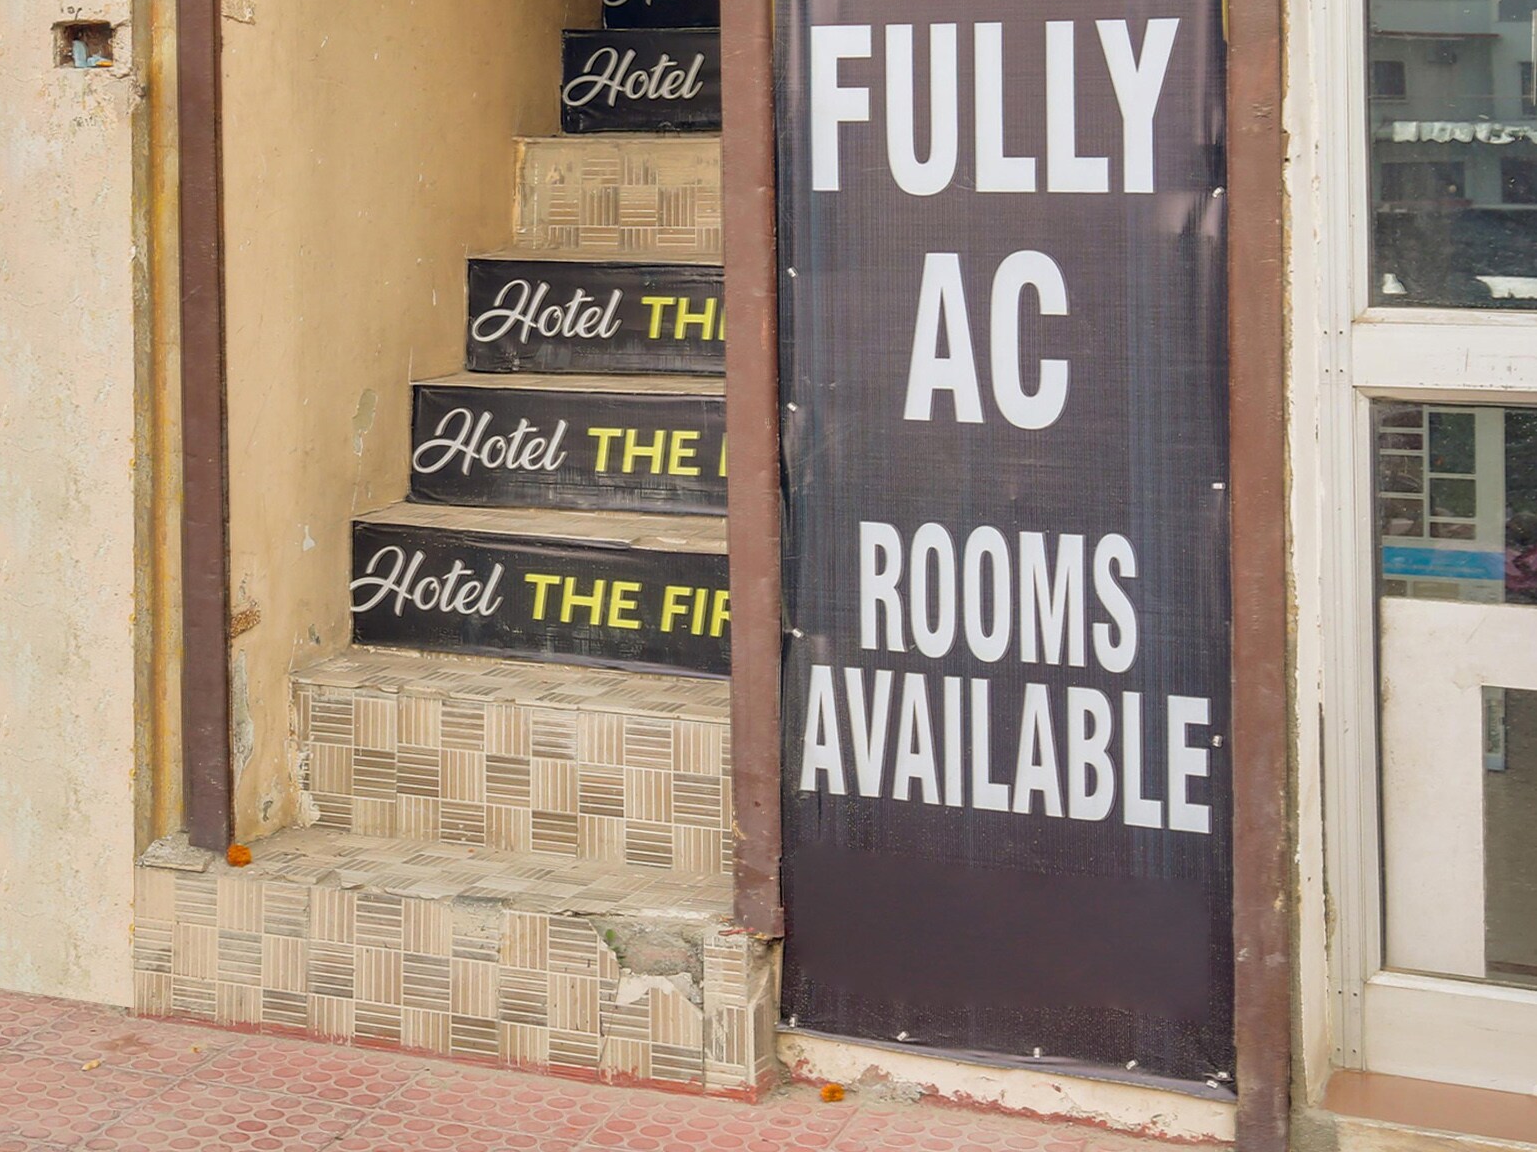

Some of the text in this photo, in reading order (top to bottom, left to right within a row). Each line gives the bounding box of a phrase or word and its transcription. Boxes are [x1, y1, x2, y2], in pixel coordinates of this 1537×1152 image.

[563, 47, 704, 107] Hotel
[810, 18, 1180, 195] FULLY
[471, 279, 724, 344] Hotel TH
[903, 249, 1071, 430] AC
[412, 408, 568, 475] Hotel
[587, 427, 701, 477] THE
[350, 546, 504, 617] Hotel
[525, 573, 642, 630] THE
[859, 521, 1139, 674] ROOMS
[799, 663, 1212, 834] AVAILABLE
